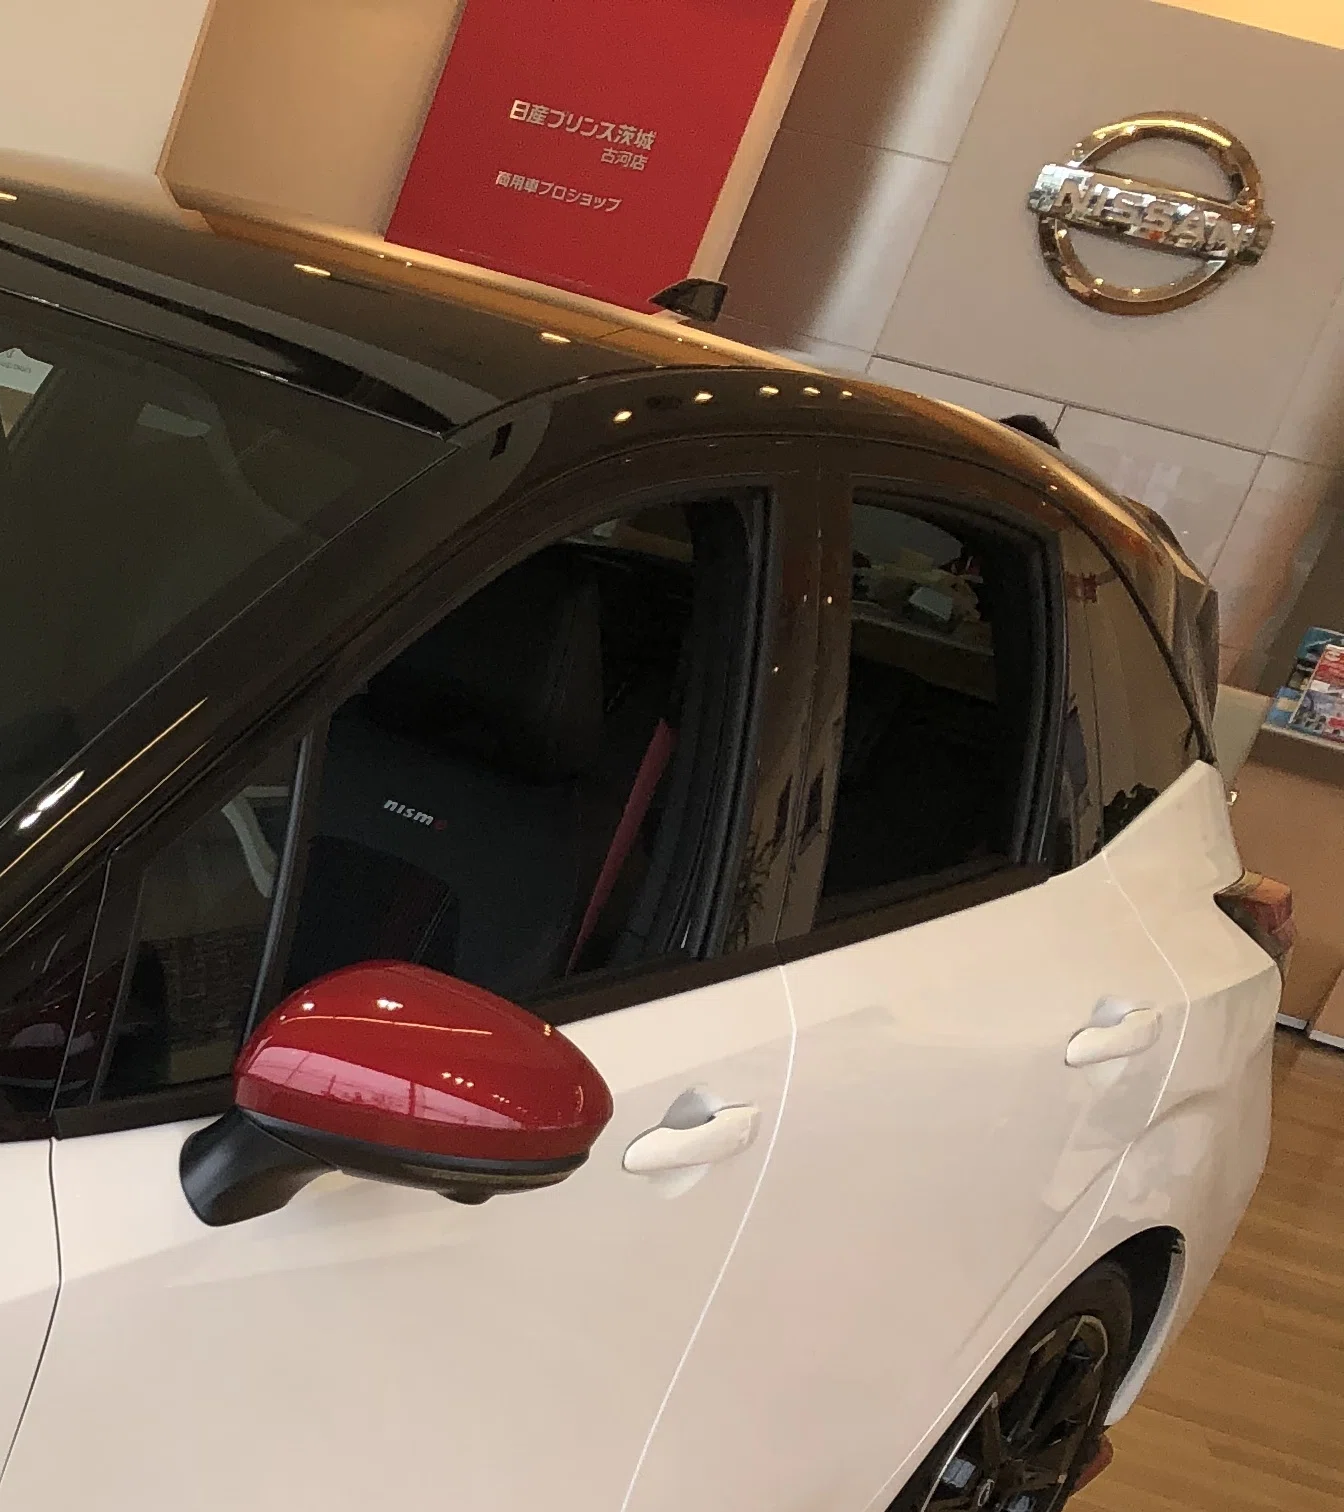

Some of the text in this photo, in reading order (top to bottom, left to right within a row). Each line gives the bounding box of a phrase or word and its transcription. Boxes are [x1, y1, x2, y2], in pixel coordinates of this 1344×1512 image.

[510, 99, 658, 151] 日産プリンス茨城
[600, 147, 649, 171] 古河店
[495, 170, 623, 212] 商用車プロショップ
[1053, 178, 1254, 258] NISSAN
